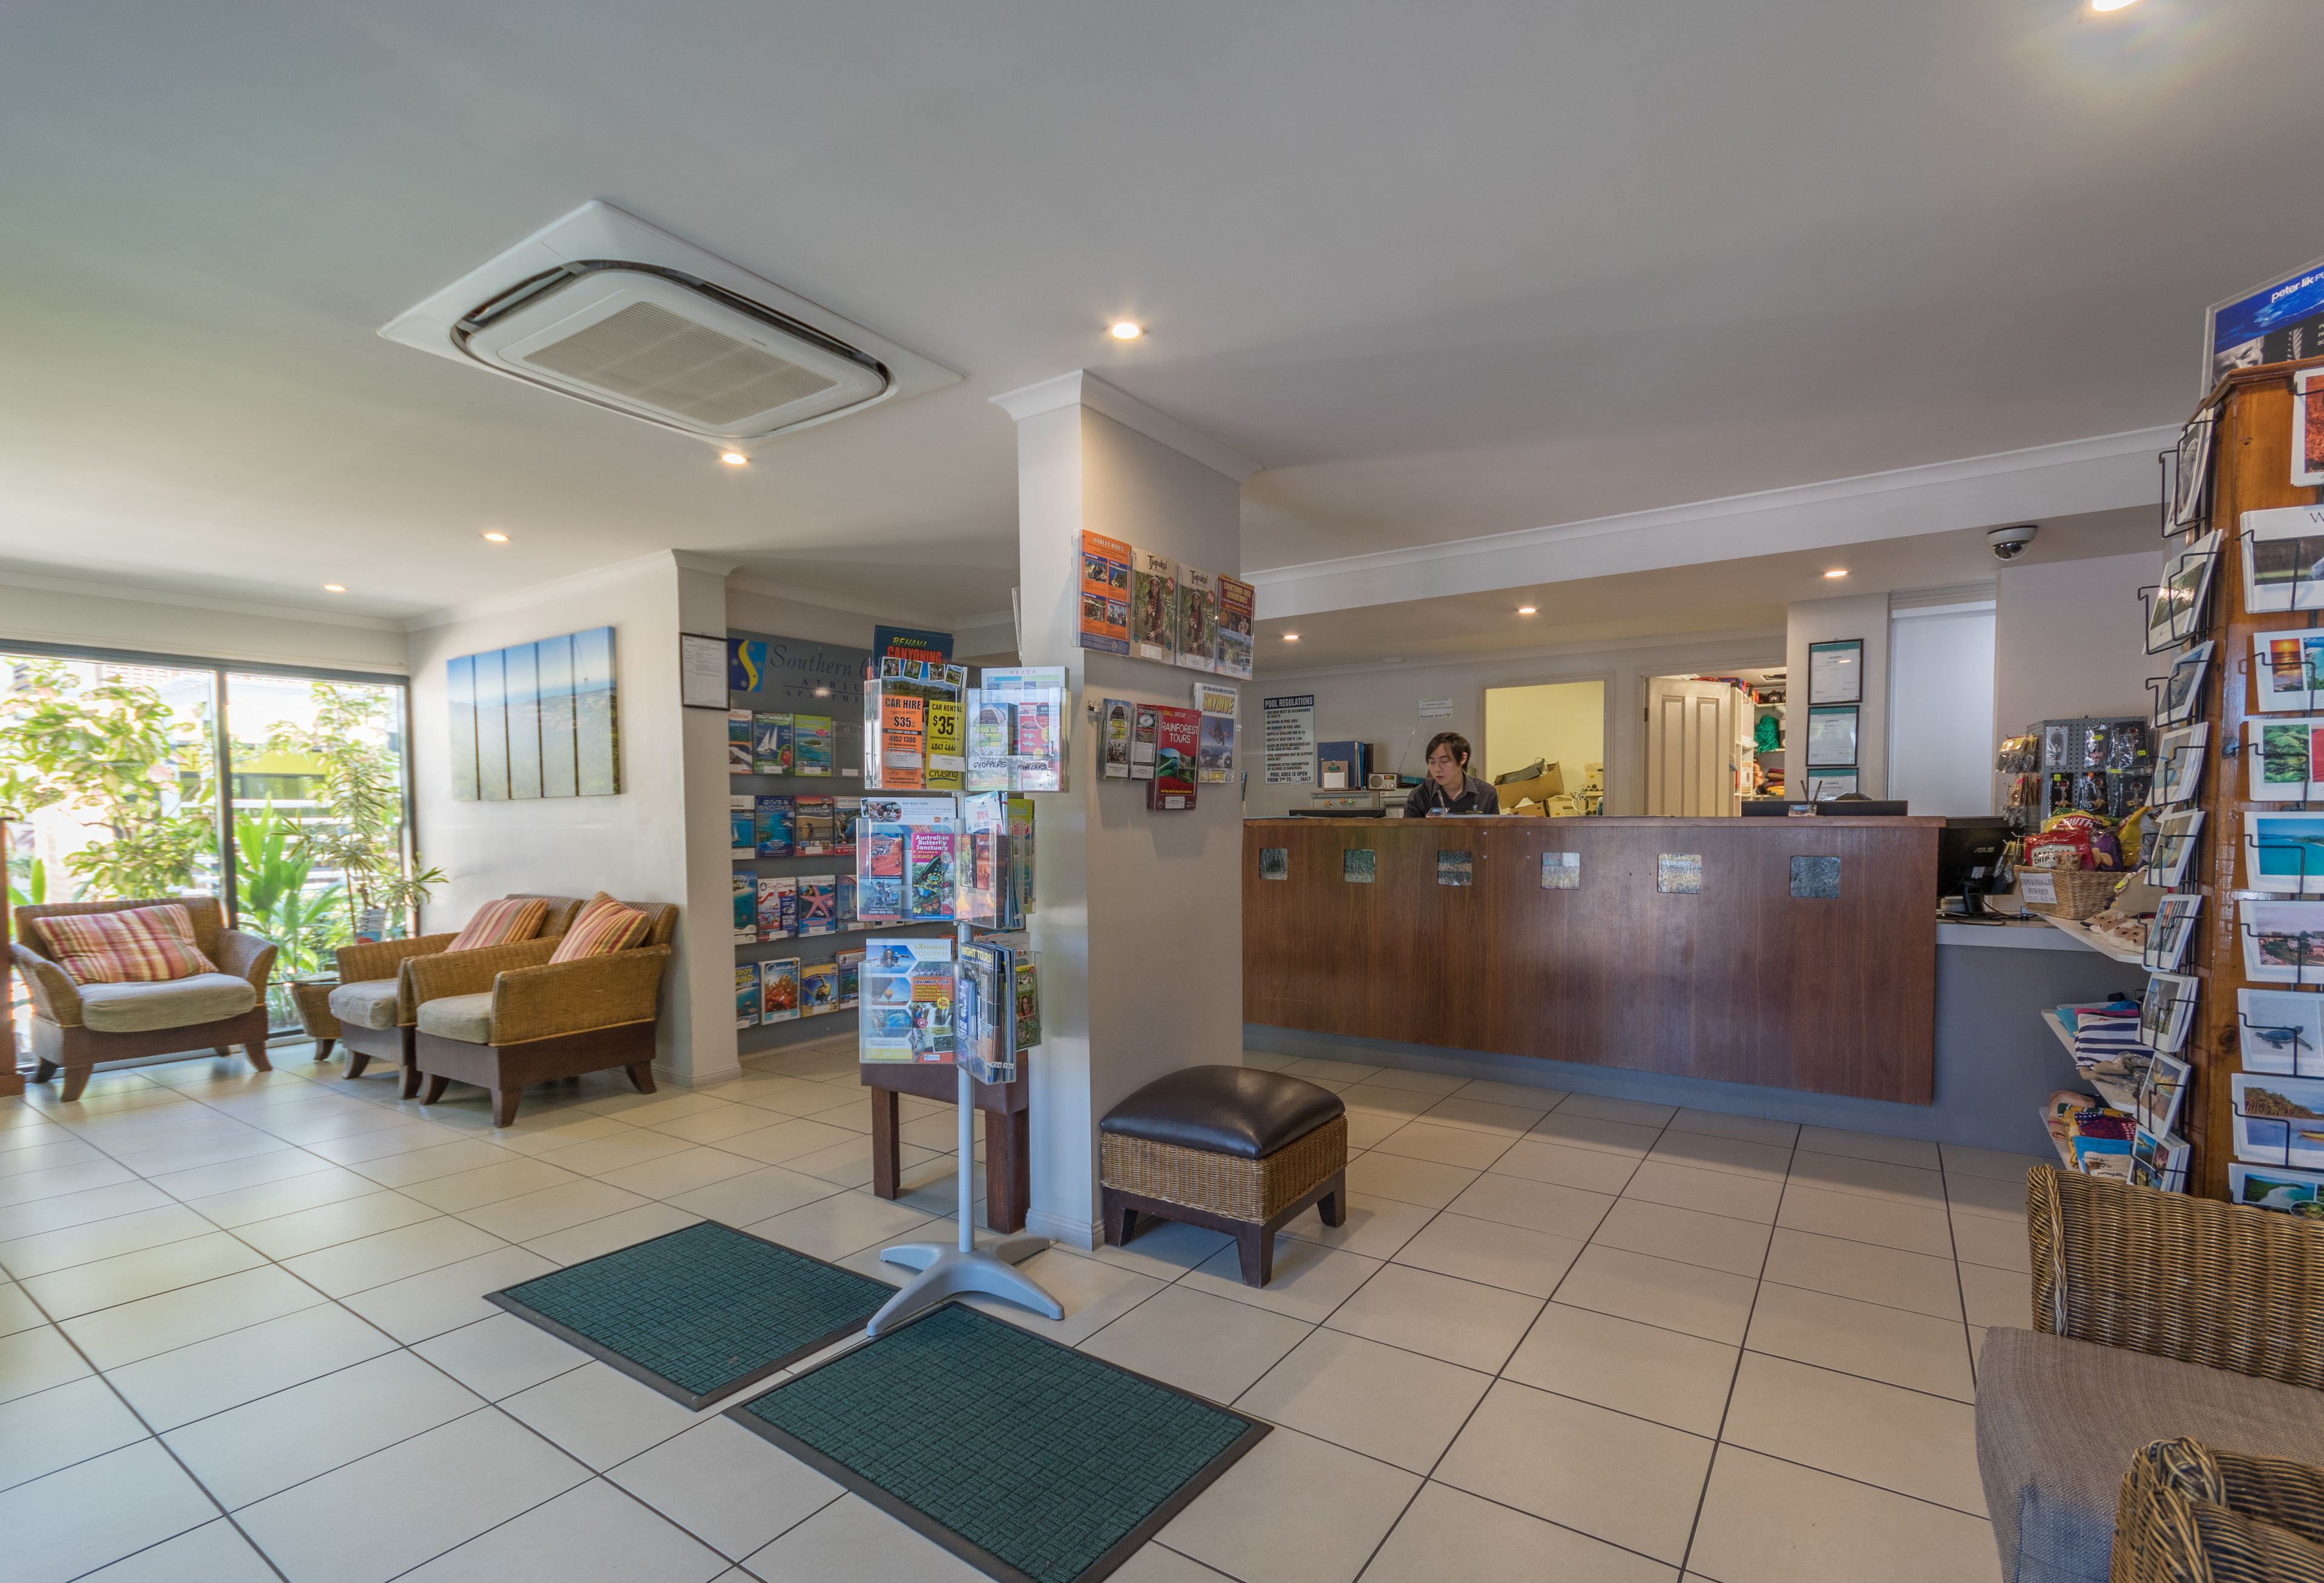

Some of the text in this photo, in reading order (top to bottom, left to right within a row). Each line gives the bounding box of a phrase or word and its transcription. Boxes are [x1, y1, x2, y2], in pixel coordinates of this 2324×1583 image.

[2271, 276, 2313, 303] peter lik
[1093, 537, 1111, 547] HARLEY
[1111, 542, 1124, 551] RIDES
[1147, 555, 1167, 571] Tjapukai
[1190, 570, 1208, 585] Tjapukai
[892, 637, 928, 648] BEHANA
[770, 644, 851, 677] Southern
[887, 645, 943, 663] CANYONING
[802, 679, 862, 691] ATRIU
[885, 697, 921, 709] CAR HIRE
[1203, 692, 1235, 714] SKYDIVE
[1265, 697, 1313, 708] POOL REGULATIONS
[894, 716, 911, 728] $35
[1162, 722, 1198, 735] RAINFOREST
[1169, 733, 1190, 743] TOURS
[931, 743, 943, 751] 4041
[847, 952, 866, 961] POSEID
[961, 946, 992, 964] NIGHT TOURS
